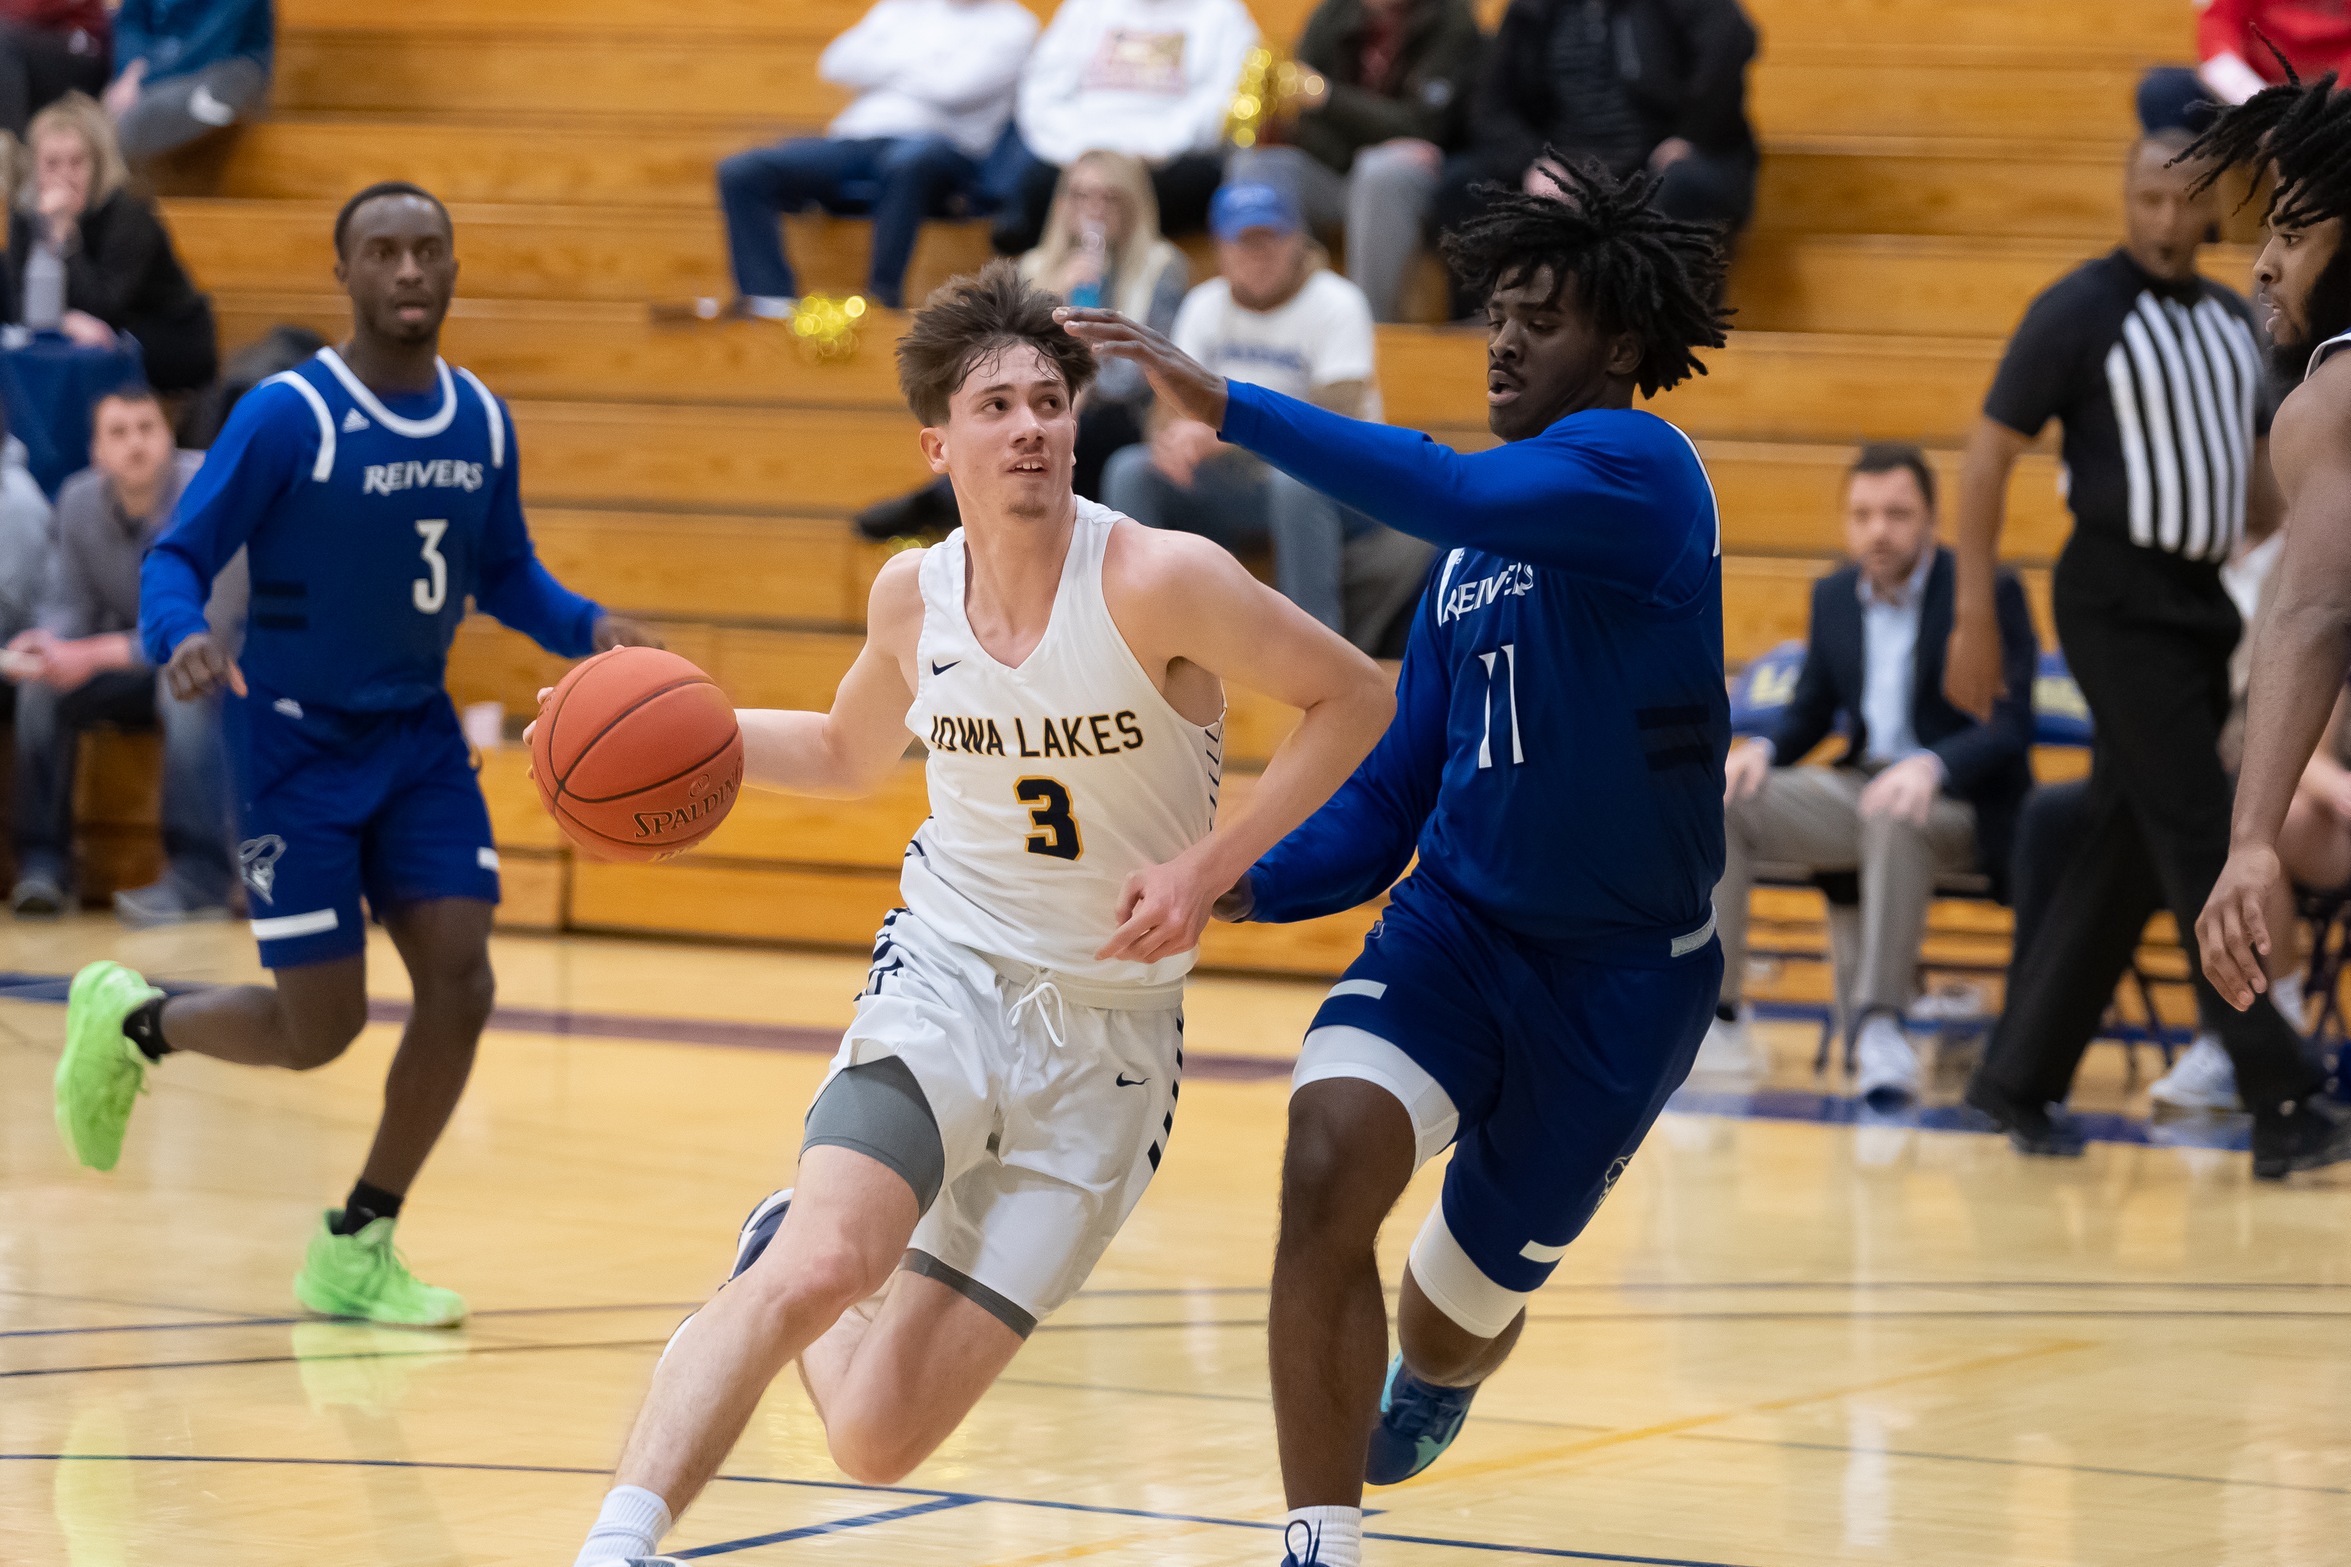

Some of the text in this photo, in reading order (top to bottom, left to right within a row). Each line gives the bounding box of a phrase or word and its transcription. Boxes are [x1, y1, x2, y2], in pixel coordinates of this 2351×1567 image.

[363, 459, 484, 497] REIVERS
[412, 518, 449, 615] 3
[930, 709, 1144, 758] IOWA LAKES
[1478, 643, 1525, 769] 11
[1013, 775, 1084, 861] 3
